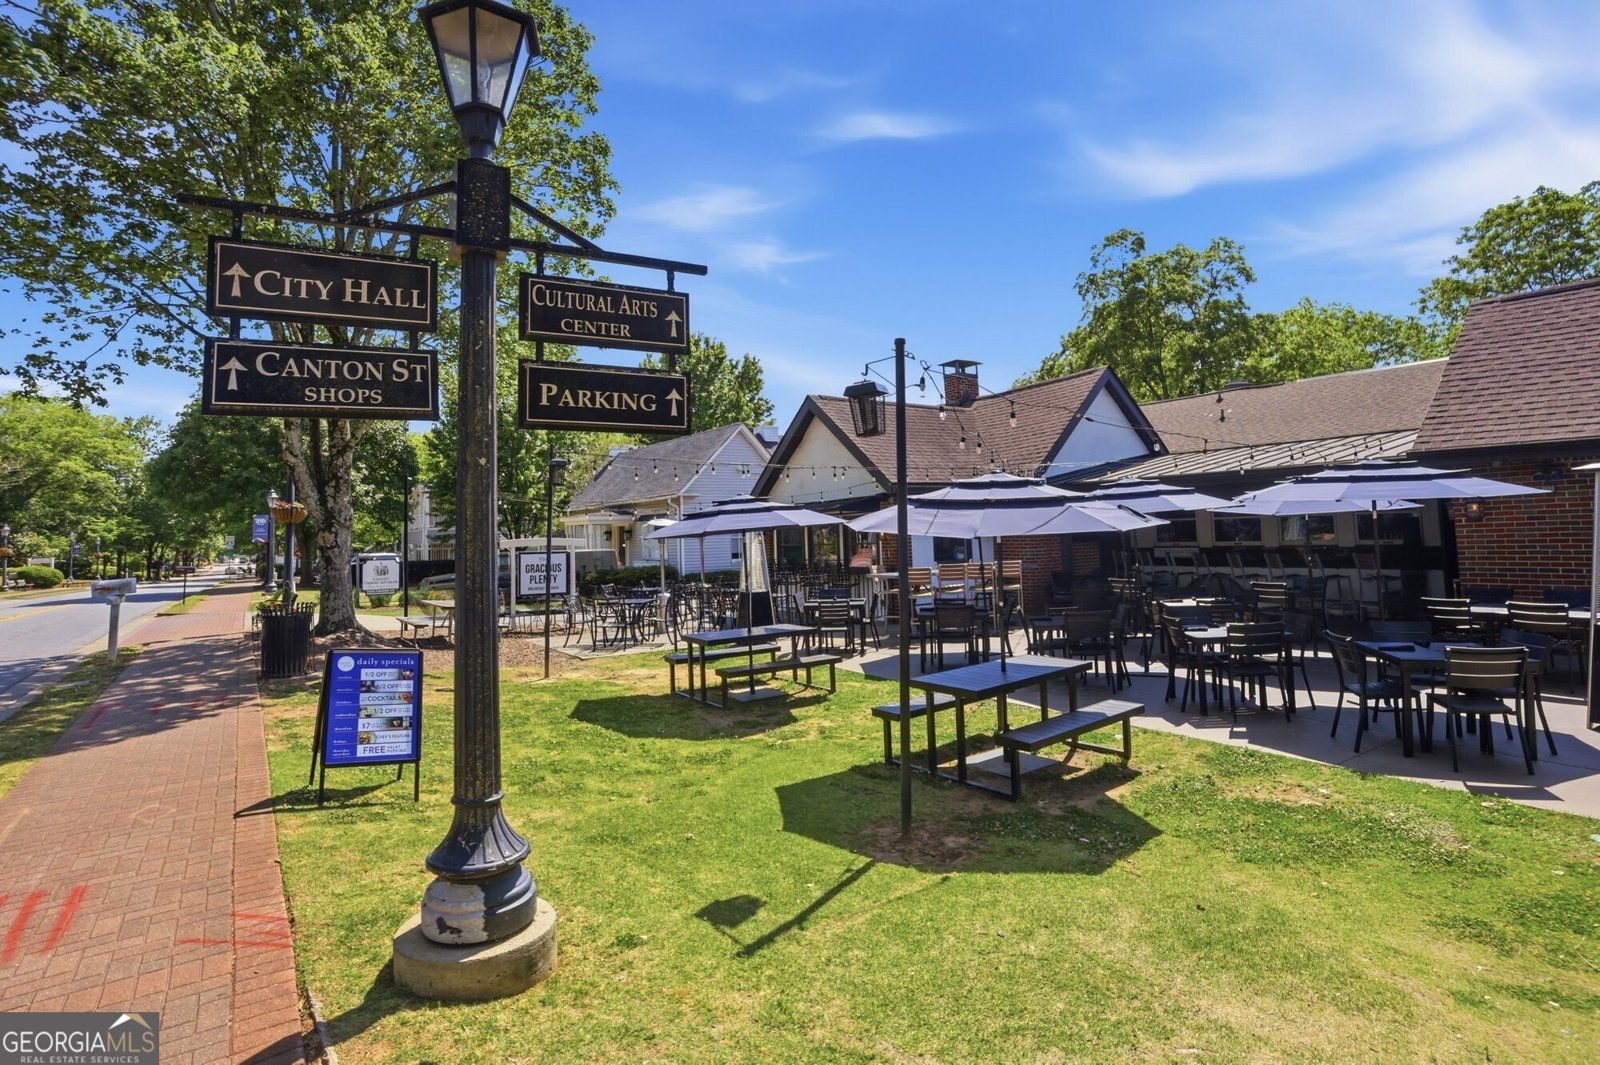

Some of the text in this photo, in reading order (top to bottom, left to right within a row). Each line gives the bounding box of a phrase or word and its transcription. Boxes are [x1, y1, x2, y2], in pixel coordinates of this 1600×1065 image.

[254, 270, 426, 309] CITY HALL
[532, 284, 658, 318] CULTURAL ARTS
[561, 318, 631, 338] CENTER
[255, 352, 427, 383] CANTON ST
[304, 386, 382, 404] SHOPS
[539, 383, 656, 412] PARKING
[525, 563, 562, 574] GRACUS
[356, 657, 378, 667] daily
[381, 657, 414, 667] specials
[363, 745, 386, 755] FREE
